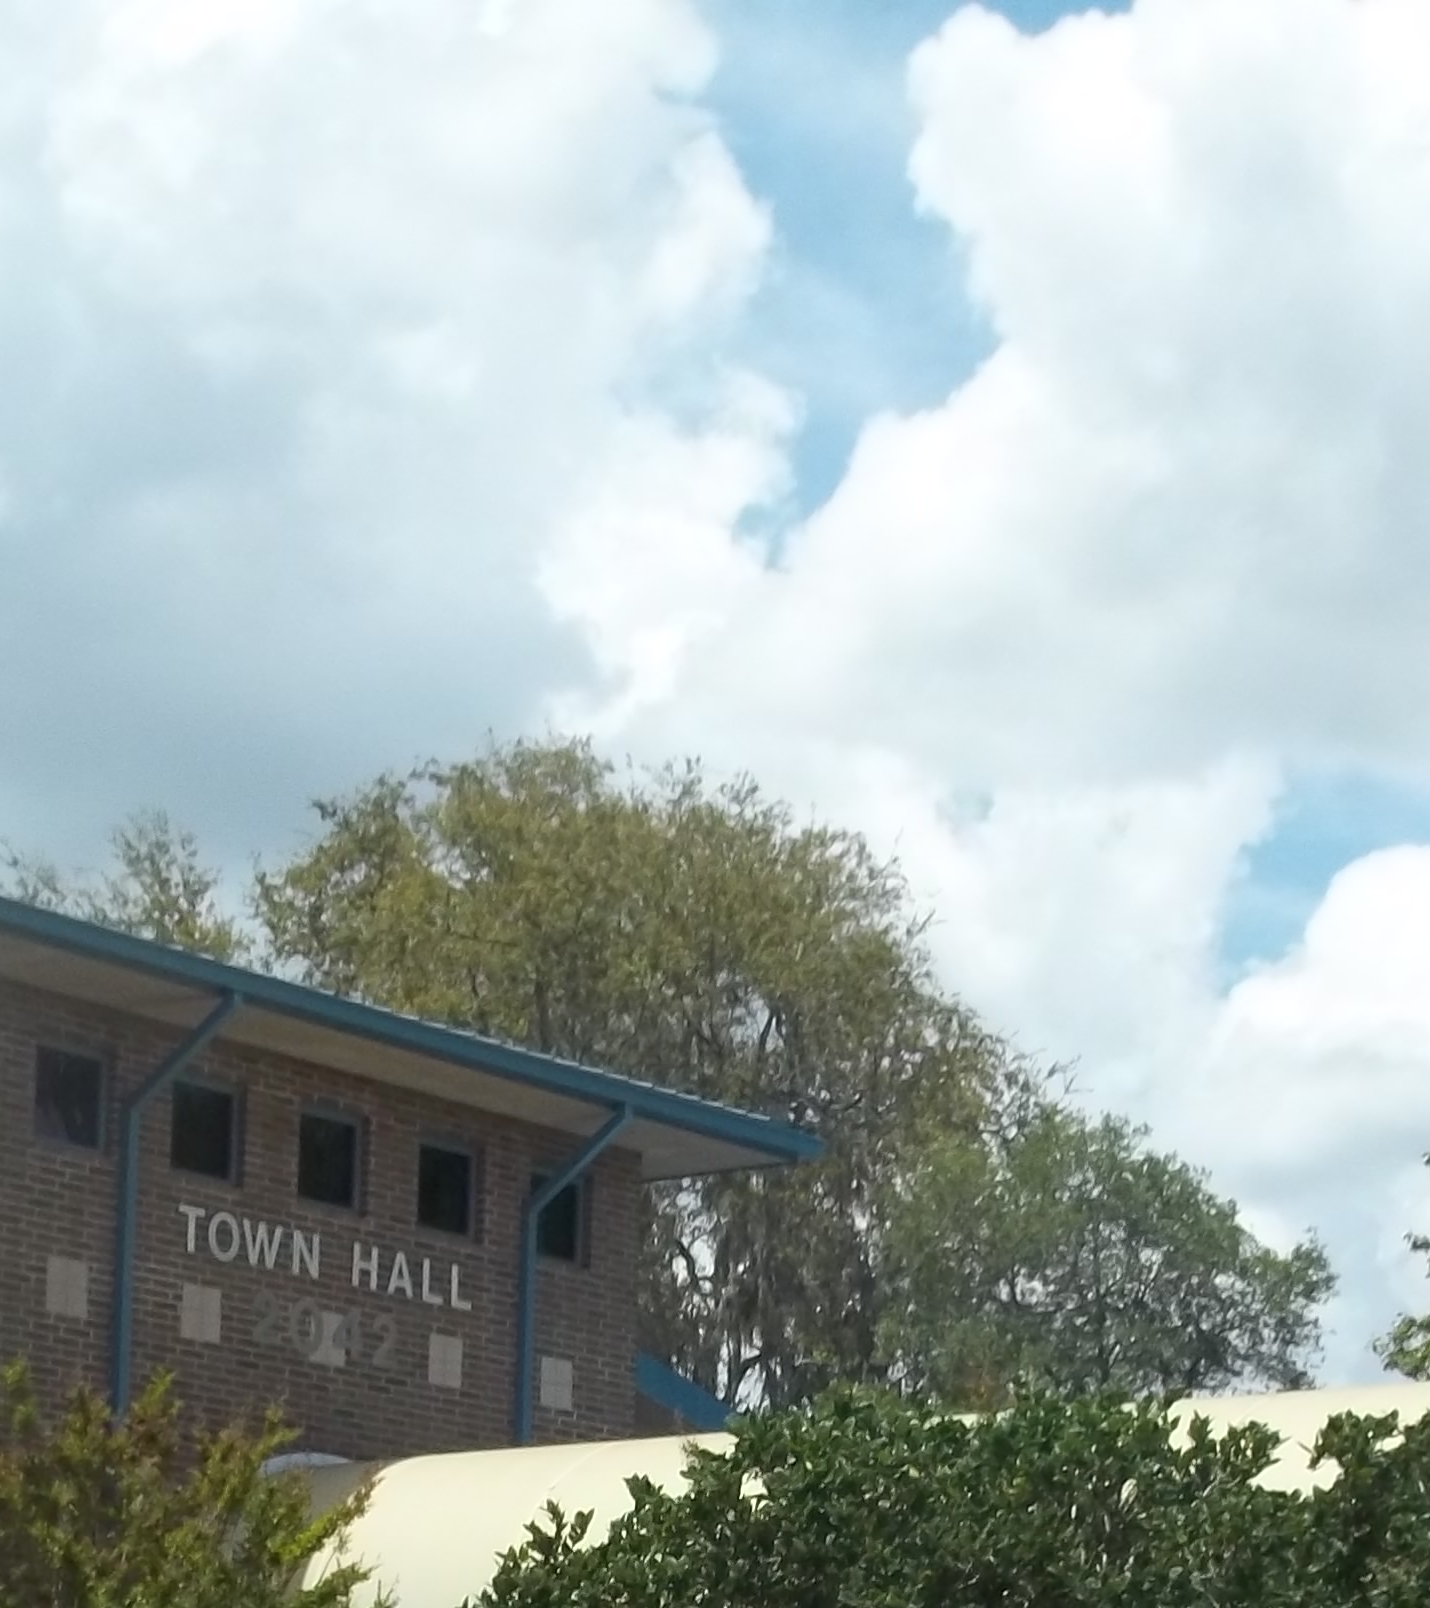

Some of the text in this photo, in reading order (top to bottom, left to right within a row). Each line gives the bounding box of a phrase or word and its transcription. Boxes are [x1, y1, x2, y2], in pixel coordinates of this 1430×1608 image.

[178, 1203, 472, 1311] TOWN HALL
[252, 1291, 397, 1367] 2042
